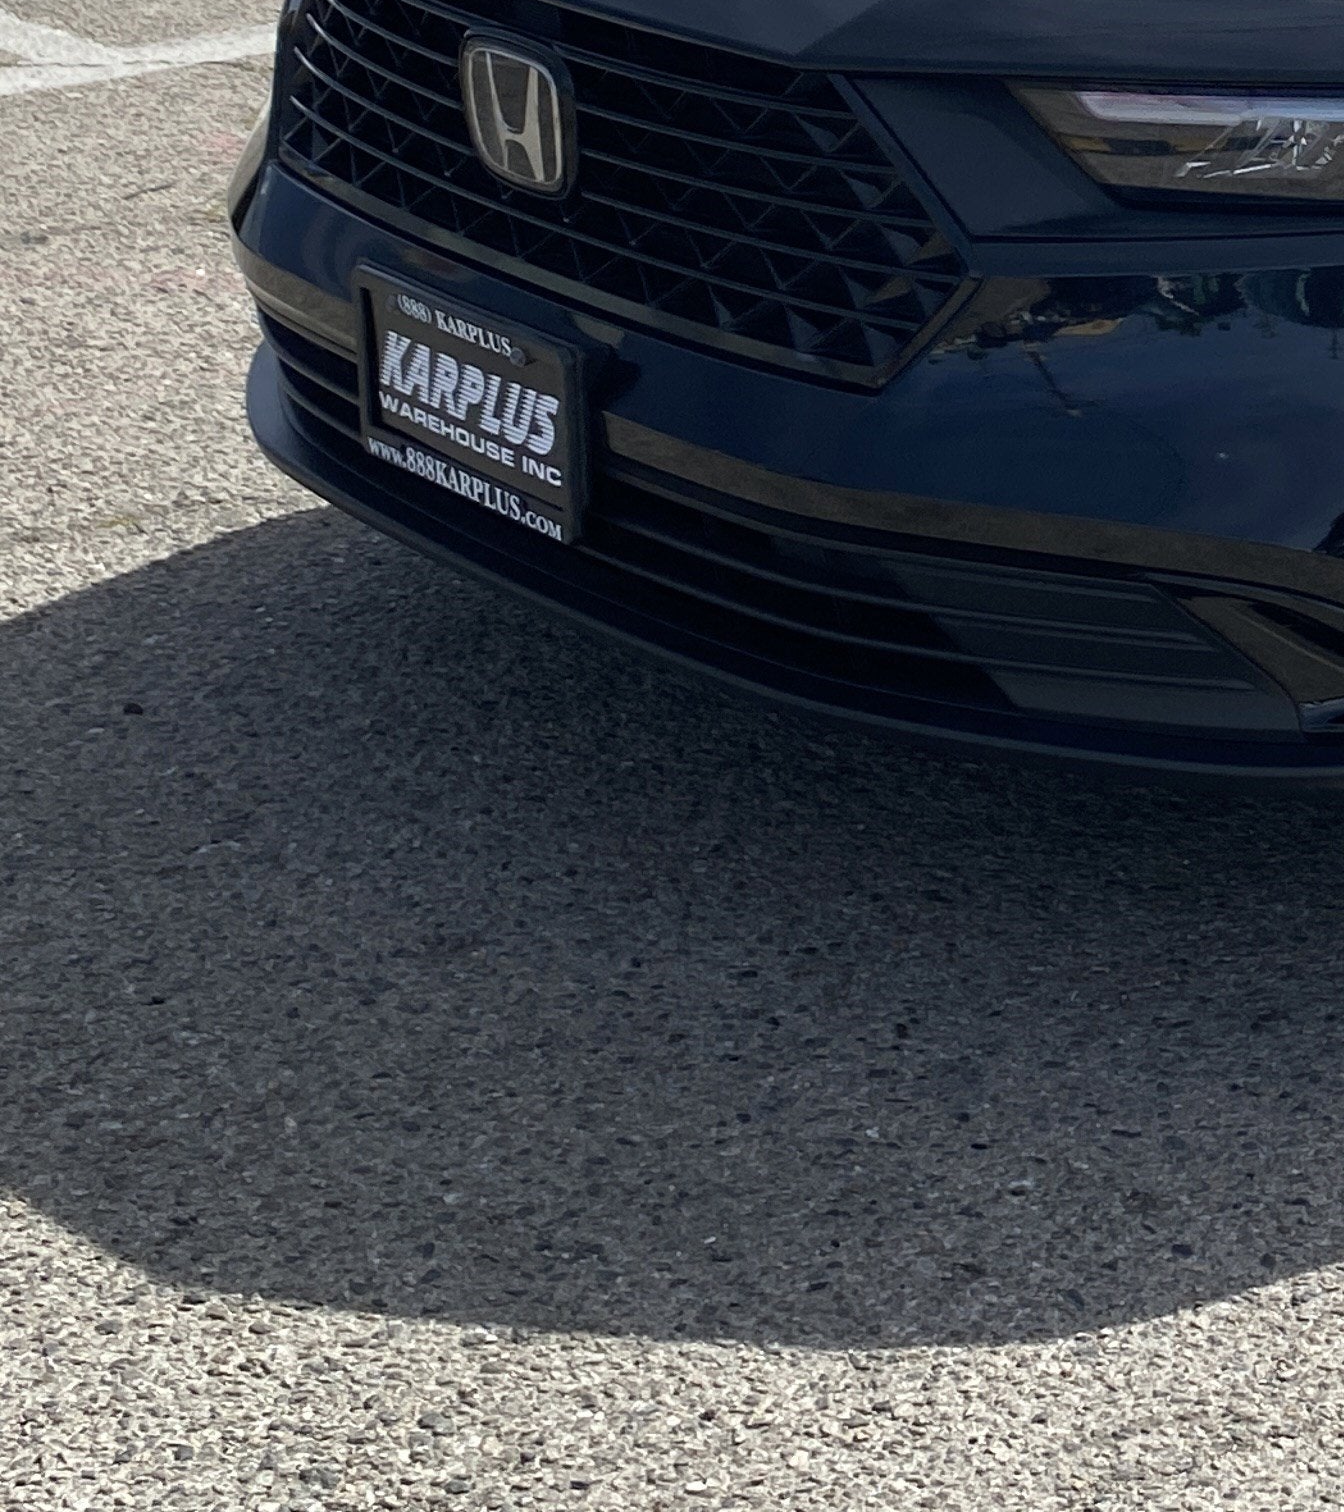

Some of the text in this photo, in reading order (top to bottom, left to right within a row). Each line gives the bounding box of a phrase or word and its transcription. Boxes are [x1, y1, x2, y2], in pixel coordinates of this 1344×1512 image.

[397, 294, 512, 356] (888) KARPLUS
[379, 330, 560, 456] KARPLUS
[379, 391, 562, 487] WAREHOUSE INC
